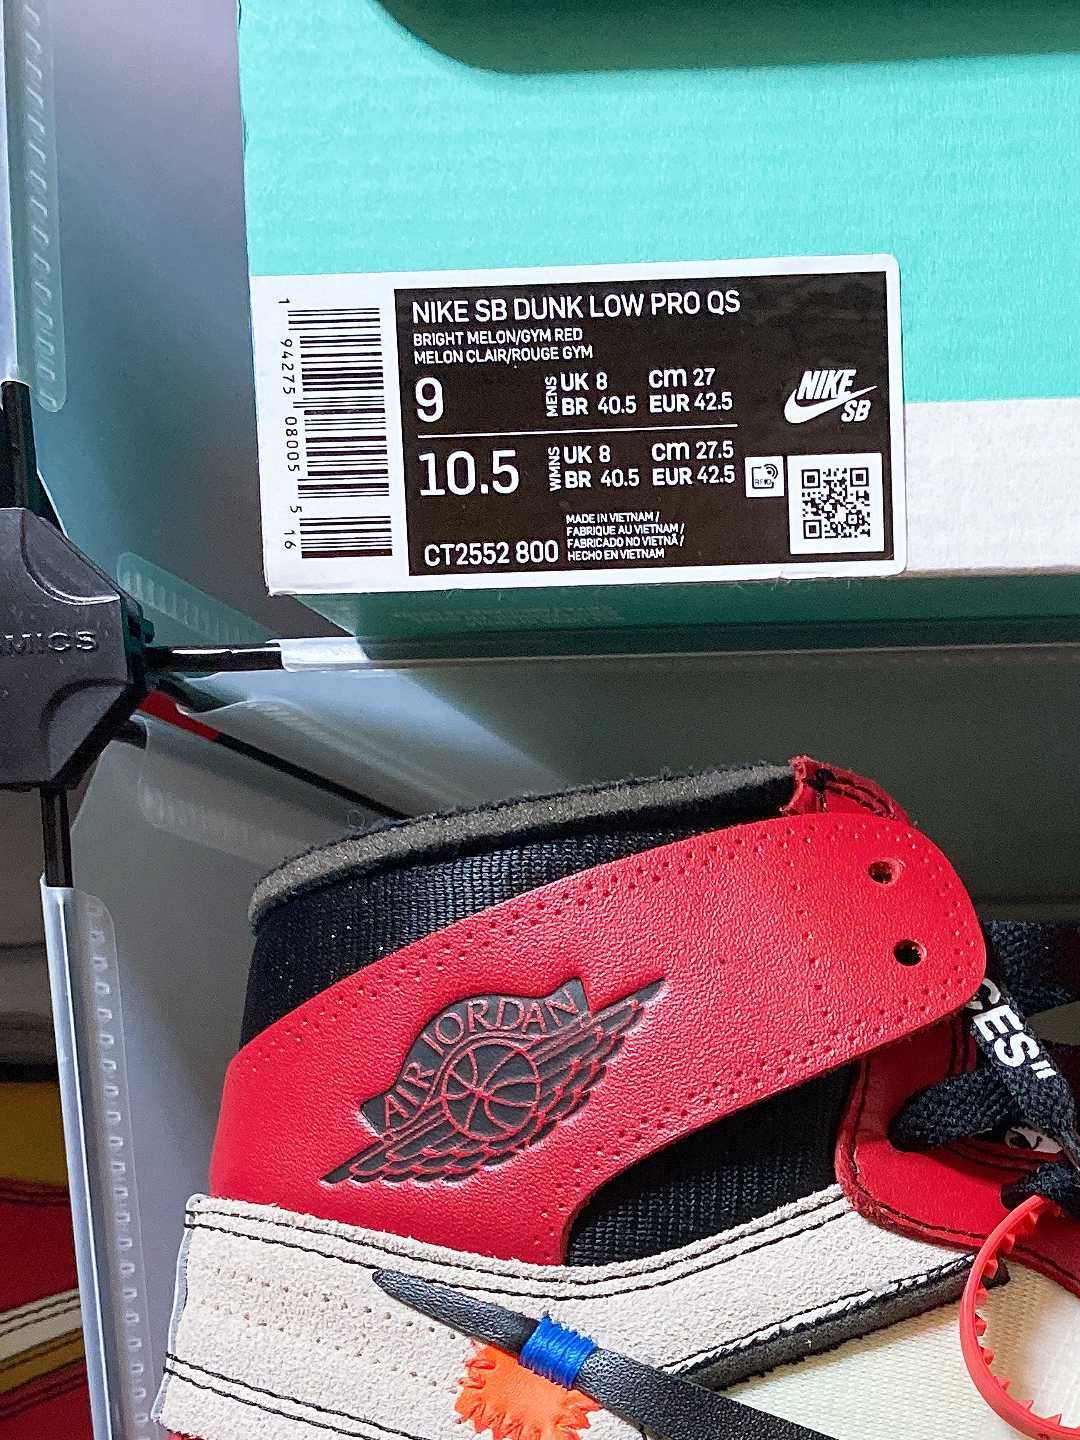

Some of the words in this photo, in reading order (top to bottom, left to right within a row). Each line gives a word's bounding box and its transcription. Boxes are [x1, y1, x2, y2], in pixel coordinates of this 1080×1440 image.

[412, 300, 470, 324] NIKE
[474, 298, 508, 322] SB
[513, 295, 585, 321] DUNK
[589, 293, 645, 318] LOW
[651, 291, 701, 315] PRO
[707, 289, 741, 316] QS
[413, 330, 464, 347] BRIGHT
[466, 328, 552, 345] MELON/GYM
[554, 327, 583, 341] RED
[413, 349, 463, 365] MELON
[466, 347, 559, 364] CLAIR/ROUGE
[562, 345, 593, 360] GYM
[279, 338, 296, 395] 94275
[560, 372, 589, 392] UK
[596, 371, 608, 390] 8
[648, 368, 688, 389] cm
[692, 367, 716, 387] 27
[796, 369, 857, 400] NIKE
[415, 376, 445, 423] 9
[544, 375, 559, 417] MENS
[561, 396, 589, 416] BR
[597, 395, 637, 415] 40.5
[649, 393, 690, 413] EUR
[693, 392, 733, 411] 42.5
[840, 399, 872, 422] SB
[284, 416, 300, 473] 08005
[563, 445, 593, 464] UK
[598, 444, 611, 463] 8
[651, 442, 690, 462] cm
[695, 440, 735, 460] 27.5
[417, 449, 520, 497] 10.5
[547, 446, 561, 491] WMNS
[564, 470, 592, 489] BR
[600, 468, 640, 488] 40.5
[652, 467, 693, 487] EUR
[696, 465, 736, 485] 42.5
[289, 505, 303, 514] 5
[565, 513, 595, 524] MADE
[596, 513, 608, 523] IN
[609, 512, 654, 523] VIETNAM
[283, 531, 297, 550] 16
[566, 525, 616, 536] FABRIQUE
[618, 525, 633, 535] AU
[633, 523, 679, 534] VIETNAM
[566, 537, 624, 548] FABRICADO
[625, 536, 641, 546] NO
[423, 542, 511, 567] CT2552
[515, 540, 559, 563] 800
[567, 550, 603, 561] HECHO
[604, 549, 619, 560] EN
[619, 548, 665, 560] VIETNAM
[383, 1060, 437, 1127] AIR
[421, 986, 581, 1056] JORDAN
